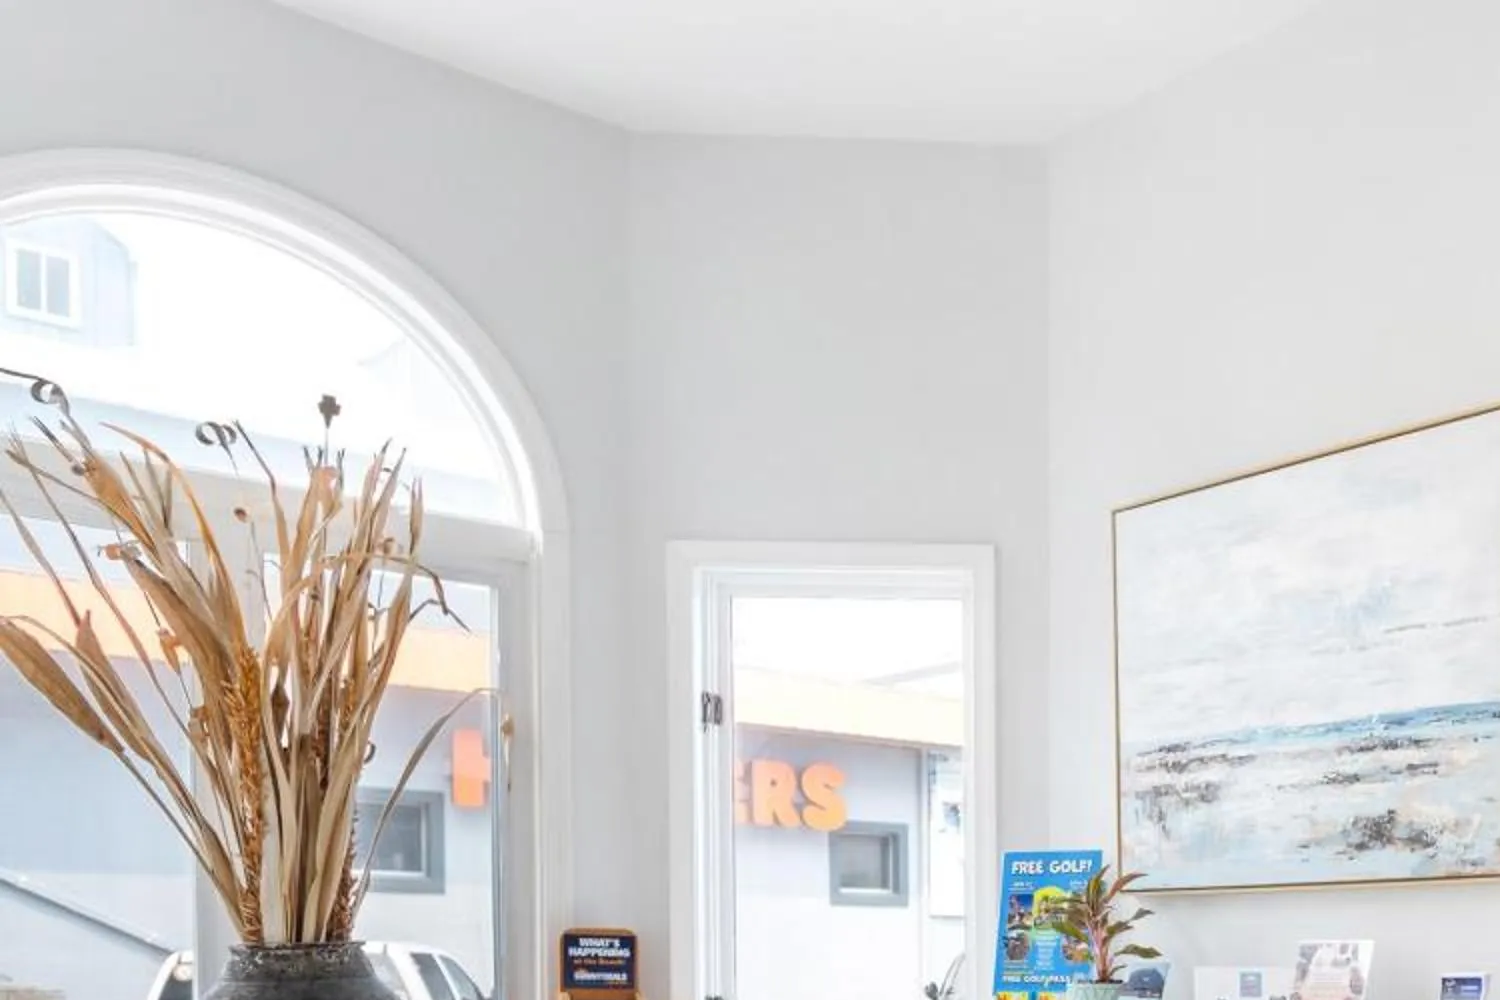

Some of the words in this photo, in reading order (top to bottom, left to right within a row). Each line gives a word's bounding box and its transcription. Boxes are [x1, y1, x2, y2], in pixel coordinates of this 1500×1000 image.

[1011, 861, 1044, 874] FREE
[579, 937, 620, 947] WHAT'S
[568, 947, 631, 958] HAPPENING
